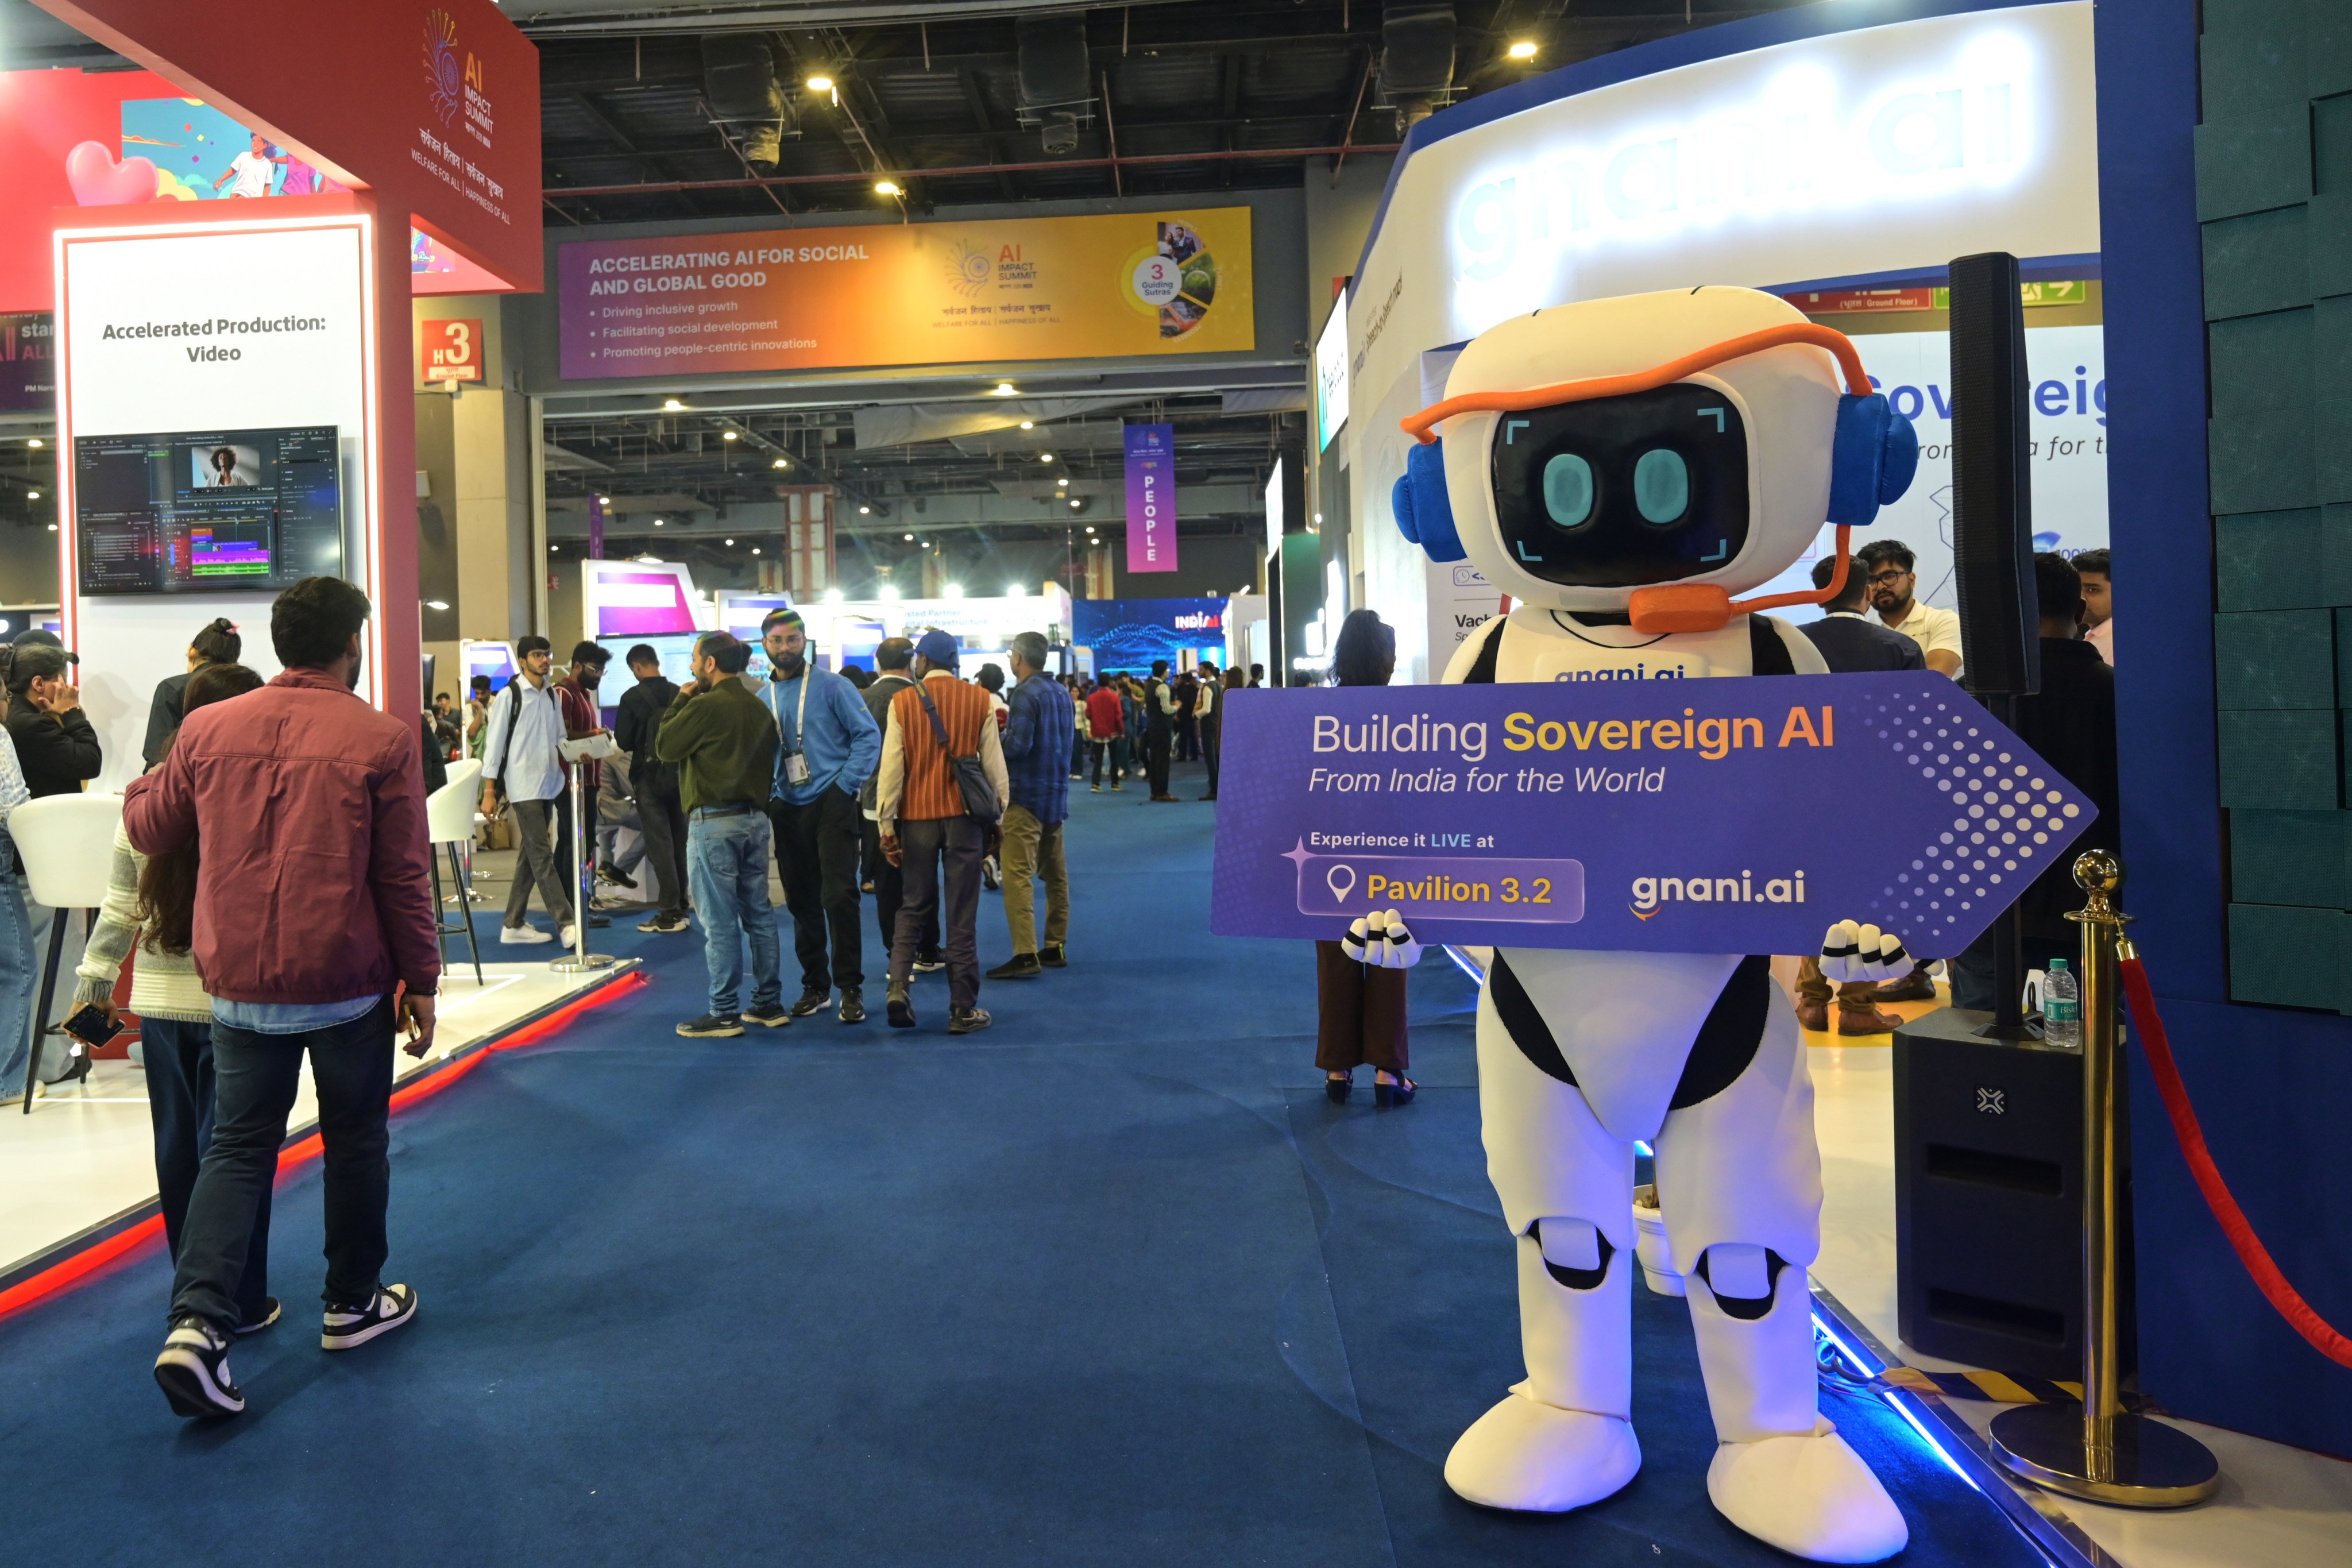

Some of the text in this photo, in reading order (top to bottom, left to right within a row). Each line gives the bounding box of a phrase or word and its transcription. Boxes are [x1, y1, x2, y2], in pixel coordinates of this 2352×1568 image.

[465, 52, 482, 92] AI
[465, 84, 491, 116] IMPACT
[465, 101, 493, 134] SUMMIT
[419, 128, 441, 155] सर्वजन
[443, 142, 460, 170] हिताय
[465, 162, 485, 187] सर्वजन
[1459, 41, 2012, 281] gnaniai
[411, 148, 510, 225] WELFARE FOR ALL HAPPINESS OF ALL
[589, 245, 869, 274] ACCELERATING AI FOR SOCIAL
[999, 244, 1021, 262] AI
[998, 263, 1035, 272] IMPACT
[998, 271, 1038, 281] SUMMIT
[1151, 264, 1164, 280] 3
[590, 272, 767, 296] AND GLOBAL GOOD
[1142, 281, 1173, 289] Guiding
[603, 302, 738, 319] Driving inclusive growth
[1867, 299, 1893, 307] Ground
[102, 315, 326, 340] Accelerated Production:
[604, 319, 778, 338] Facilitating social development
[999, 317, 1036, 325] HAPPINESS
[187, 346, 241, 362] Video
[604, 338, 817, 358] Promoting people-centric innovations
[2046, 436, 2085, 461] for
[1144, 476, 1157, 561] PEOPLE
[926, 619, 988, 627] Infrastructure
[929, 609, 960, 617] Partner
[1555, 663, 1683, 682] naniai
[1313, 706, 1833, 762] Building Sovereign AI
[1309, 766, 1666, 793] From India for the World
[1311, 832, 1494, 849] Experience it LIVE at
[1368, 875, 1552, 903] Pavilion 3.2
[1631, 869, 1805, 909] gnani.ai
